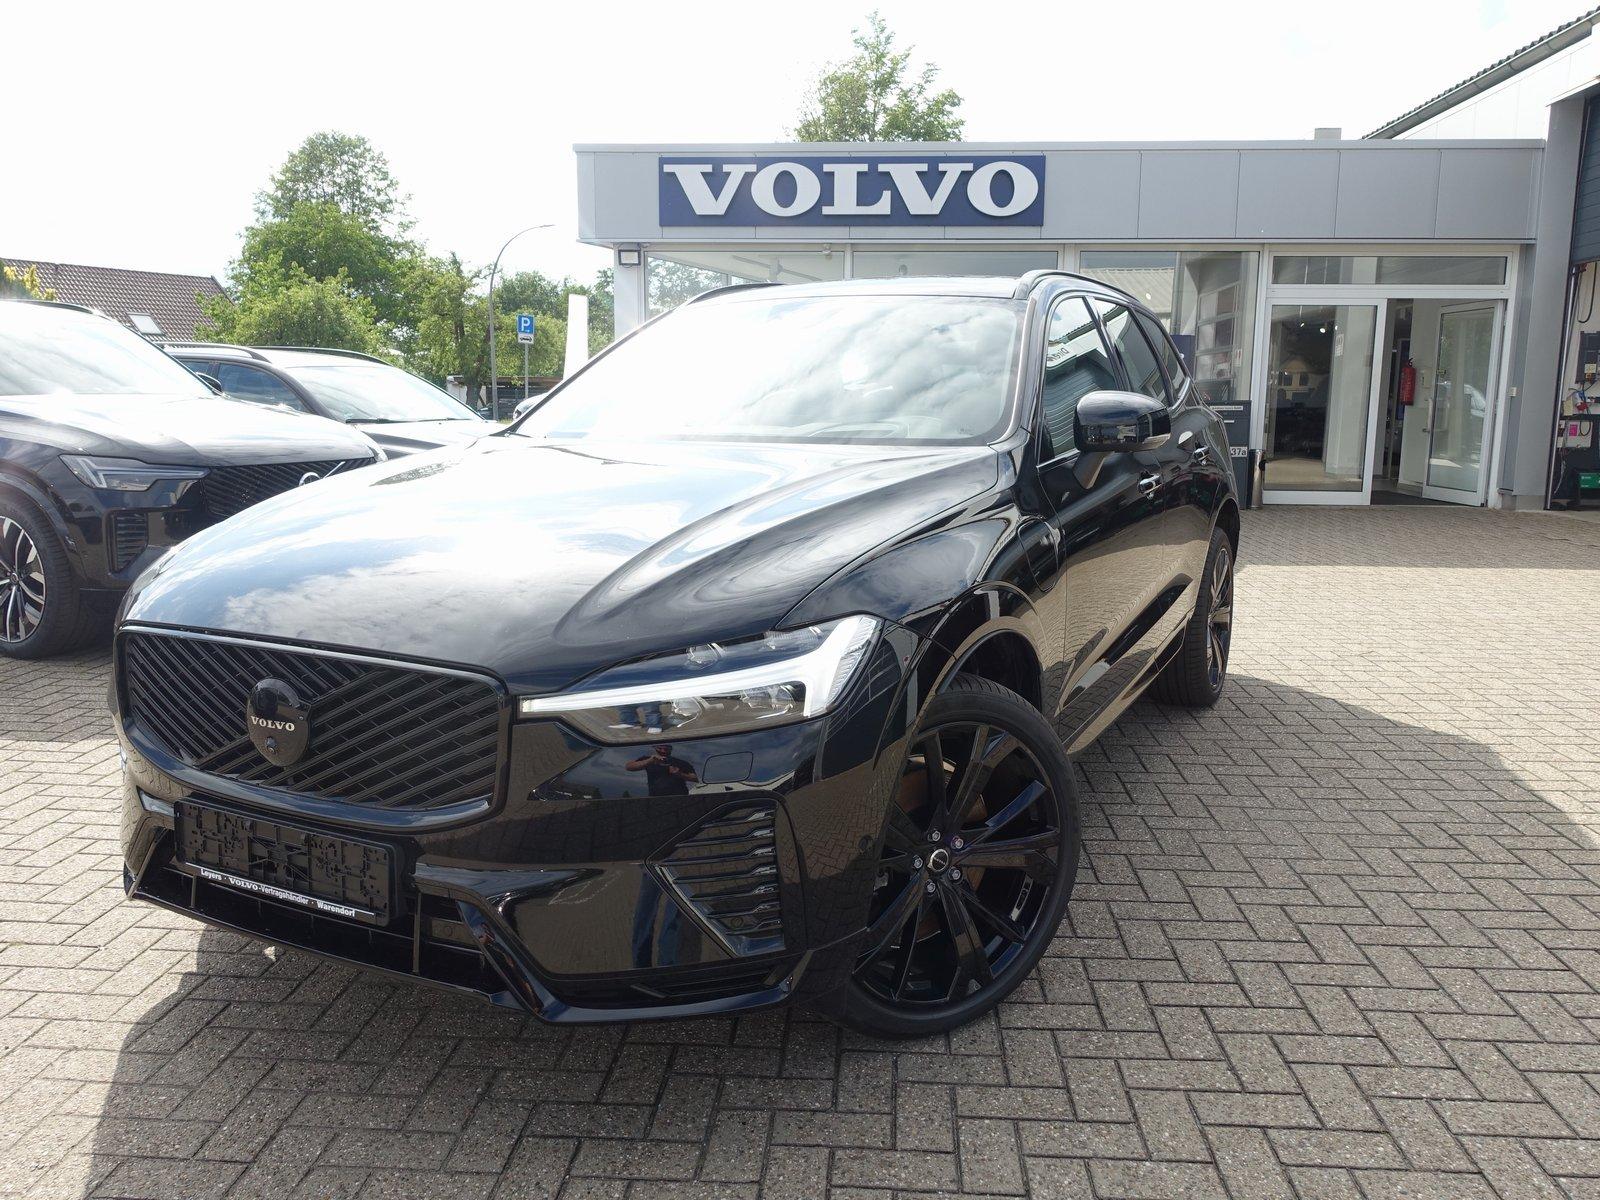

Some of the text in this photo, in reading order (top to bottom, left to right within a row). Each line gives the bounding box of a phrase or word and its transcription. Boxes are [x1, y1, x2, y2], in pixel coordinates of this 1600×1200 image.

[663, 161, 1039, 217] VOLVO
[521, 316, 531, 332] P
[1231, 447, 1247, 456] 37a
[250, 715, 295, 732] VOLVO
[200, 868, 222, 881] Leyers
[316, 900, 356, 917] Warendorf
